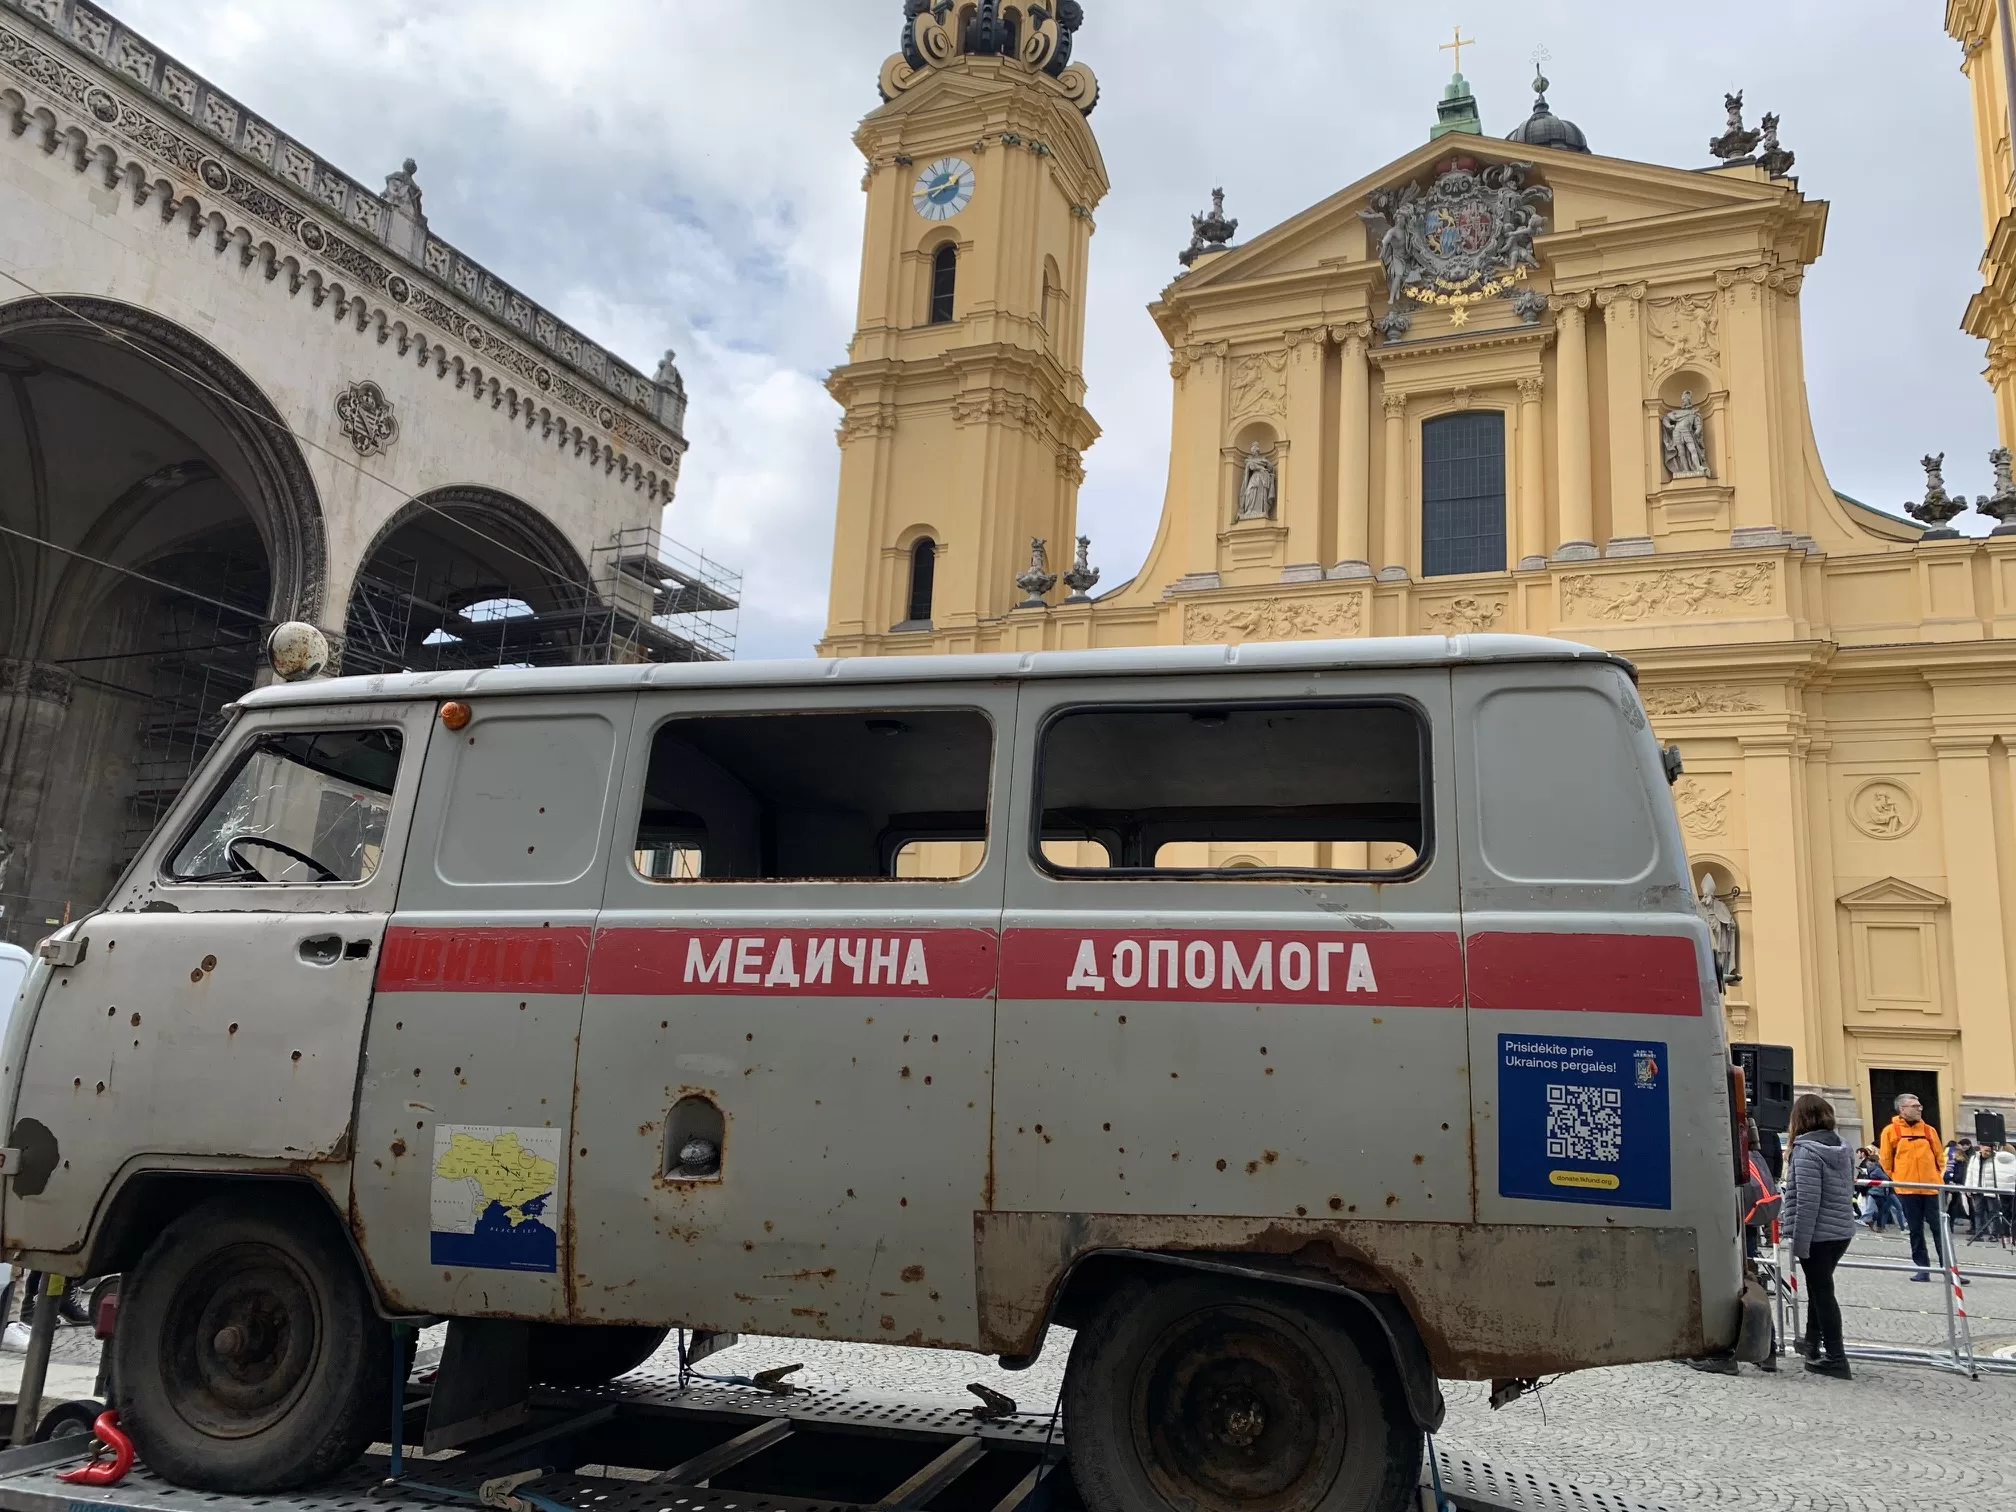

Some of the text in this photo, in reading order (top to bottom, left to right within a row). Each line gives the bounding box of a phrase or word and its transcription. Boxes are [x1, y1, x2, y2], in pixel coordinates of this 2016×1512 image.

[683, 937, 1378, 993] МЕДИЧНА ДОПОМОГА
[1505, 1040, 1594, 1058] Prisidėkite prie
[1505, 1055, 1616, 1073] Ukrainos pergalės!
